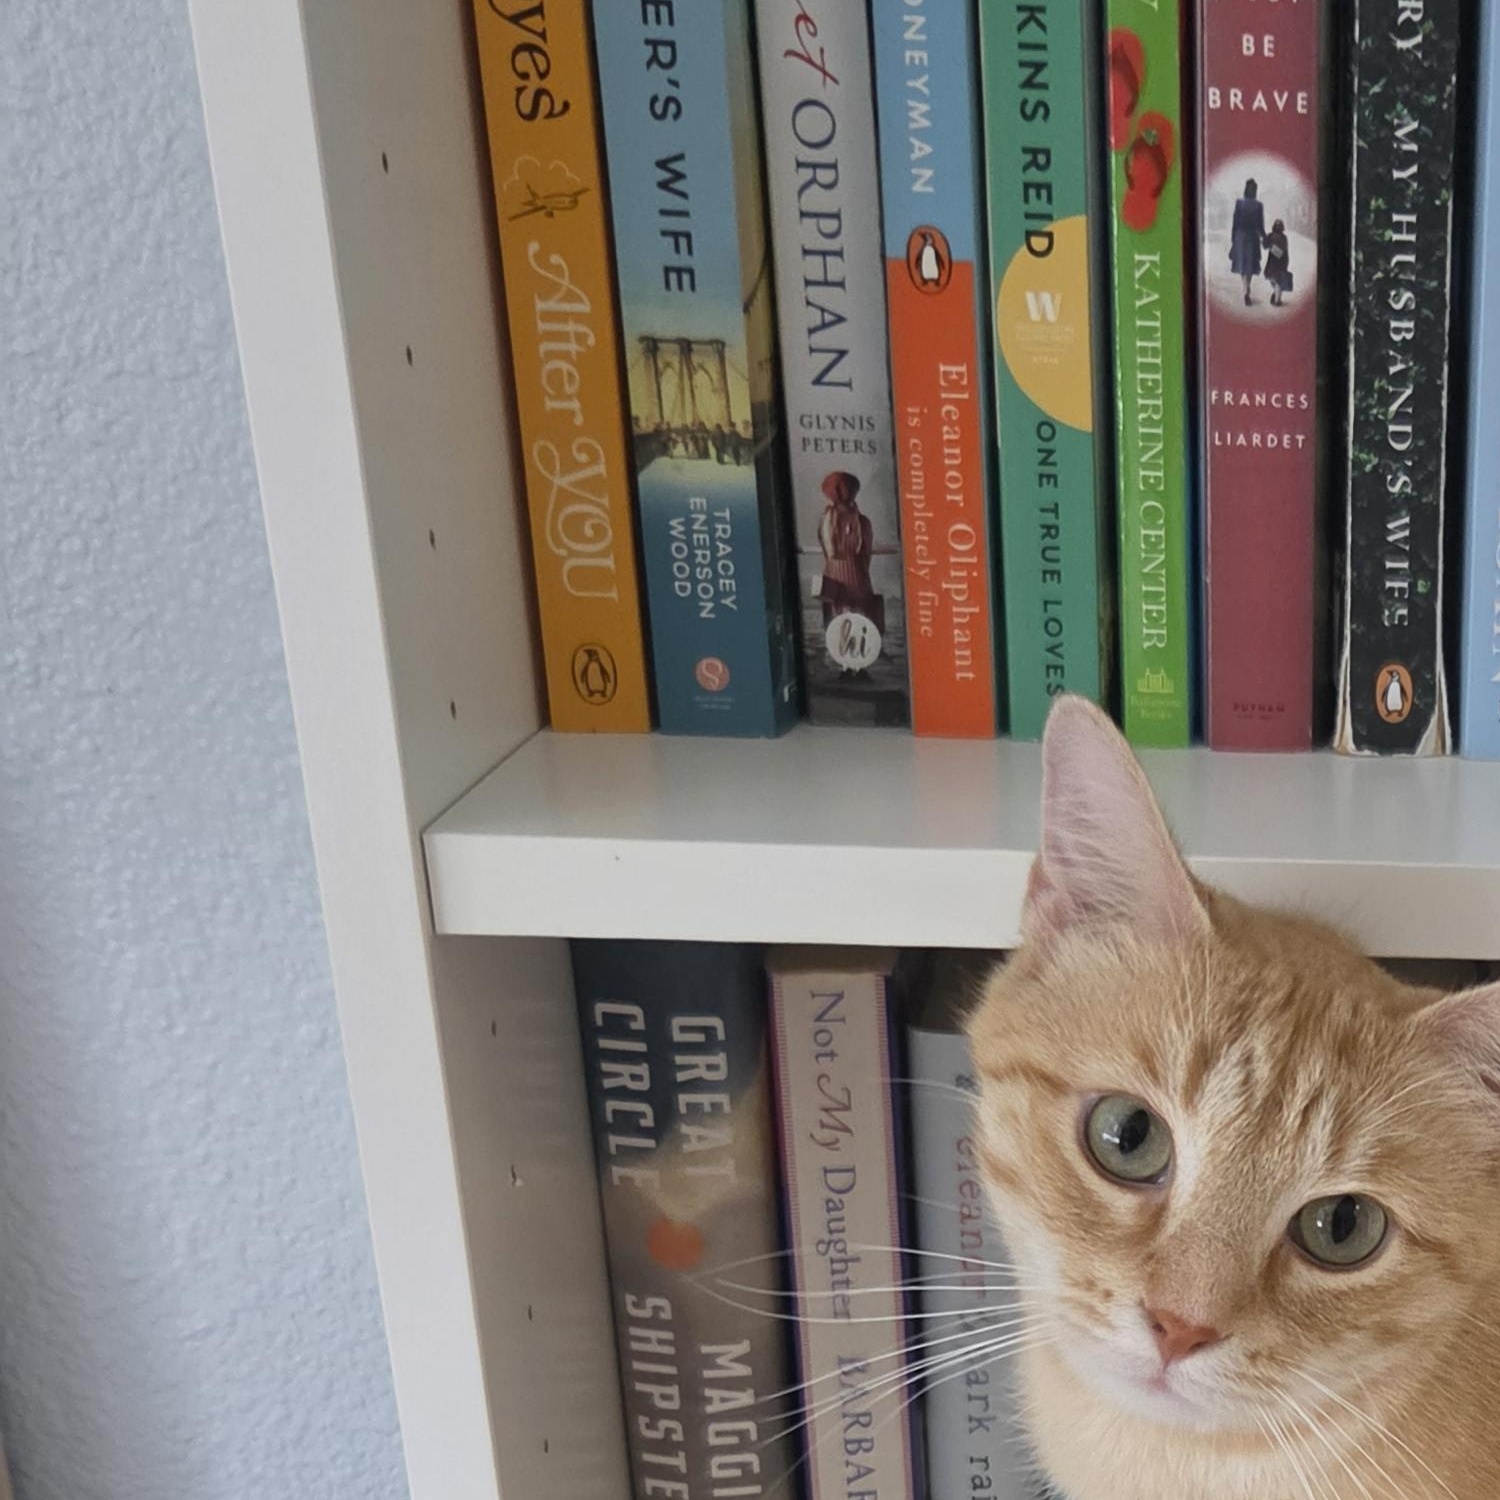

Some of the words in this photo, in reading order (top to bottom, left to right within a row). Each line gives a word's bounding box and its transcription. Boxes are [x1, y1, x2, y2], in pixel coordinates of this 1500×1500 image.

[1016, 4, 1051, 124] KINS
[1242, 34, 1276, 58] BE
[1208, 88, 1309, 114] BRAVE
[1392, 118, 1419, 189] MY
[654, 153, 697, 293] WIFE
[791, 98, 853, 392] ORPHAN
[1021, 145, 1055, 259] REID
[527, 240, 597, 427] After
[1133, 252, 1166, 491] KATHERINE
[1386, 213, 1418, 496] HUSBAND'S
[799, 413, 876, 432] GLYNIS
[801, 437, 878, 455] PETERS
[907, 407, 928, 428] is
[938, 362, 969, 507] Eleanor
[1036, 420, 1059, 488] ONE
[1211, 390, 1311, 410] FRANCES
[1214, 431, 1306, 449] LIARDET
[669, 517, 692, 597] WOOD
[689, 497, 716, 619] ENERSON
[713, 507, 738, 610] TRACEY
[907, 438, 937, 581] completely
[1038, 502, 1062, 585] TRUE
[918, 588, 939, 638] fine
[941, 522, 980, 681] Oliphant
[1138, 500, 1168, 651] CENTER
[1382, 514, 1411, 627] WIFE
[1042, 599, 1066, 696] LOVES
[810, 989, 847, 1064] Not
[594, 1002, 661, 1190] CIRCLE
[671, 1016, 737, 1185] GREAT
[809, 1074, 855, 1152] My
[815, 1165, 863, 1324] Daughter
